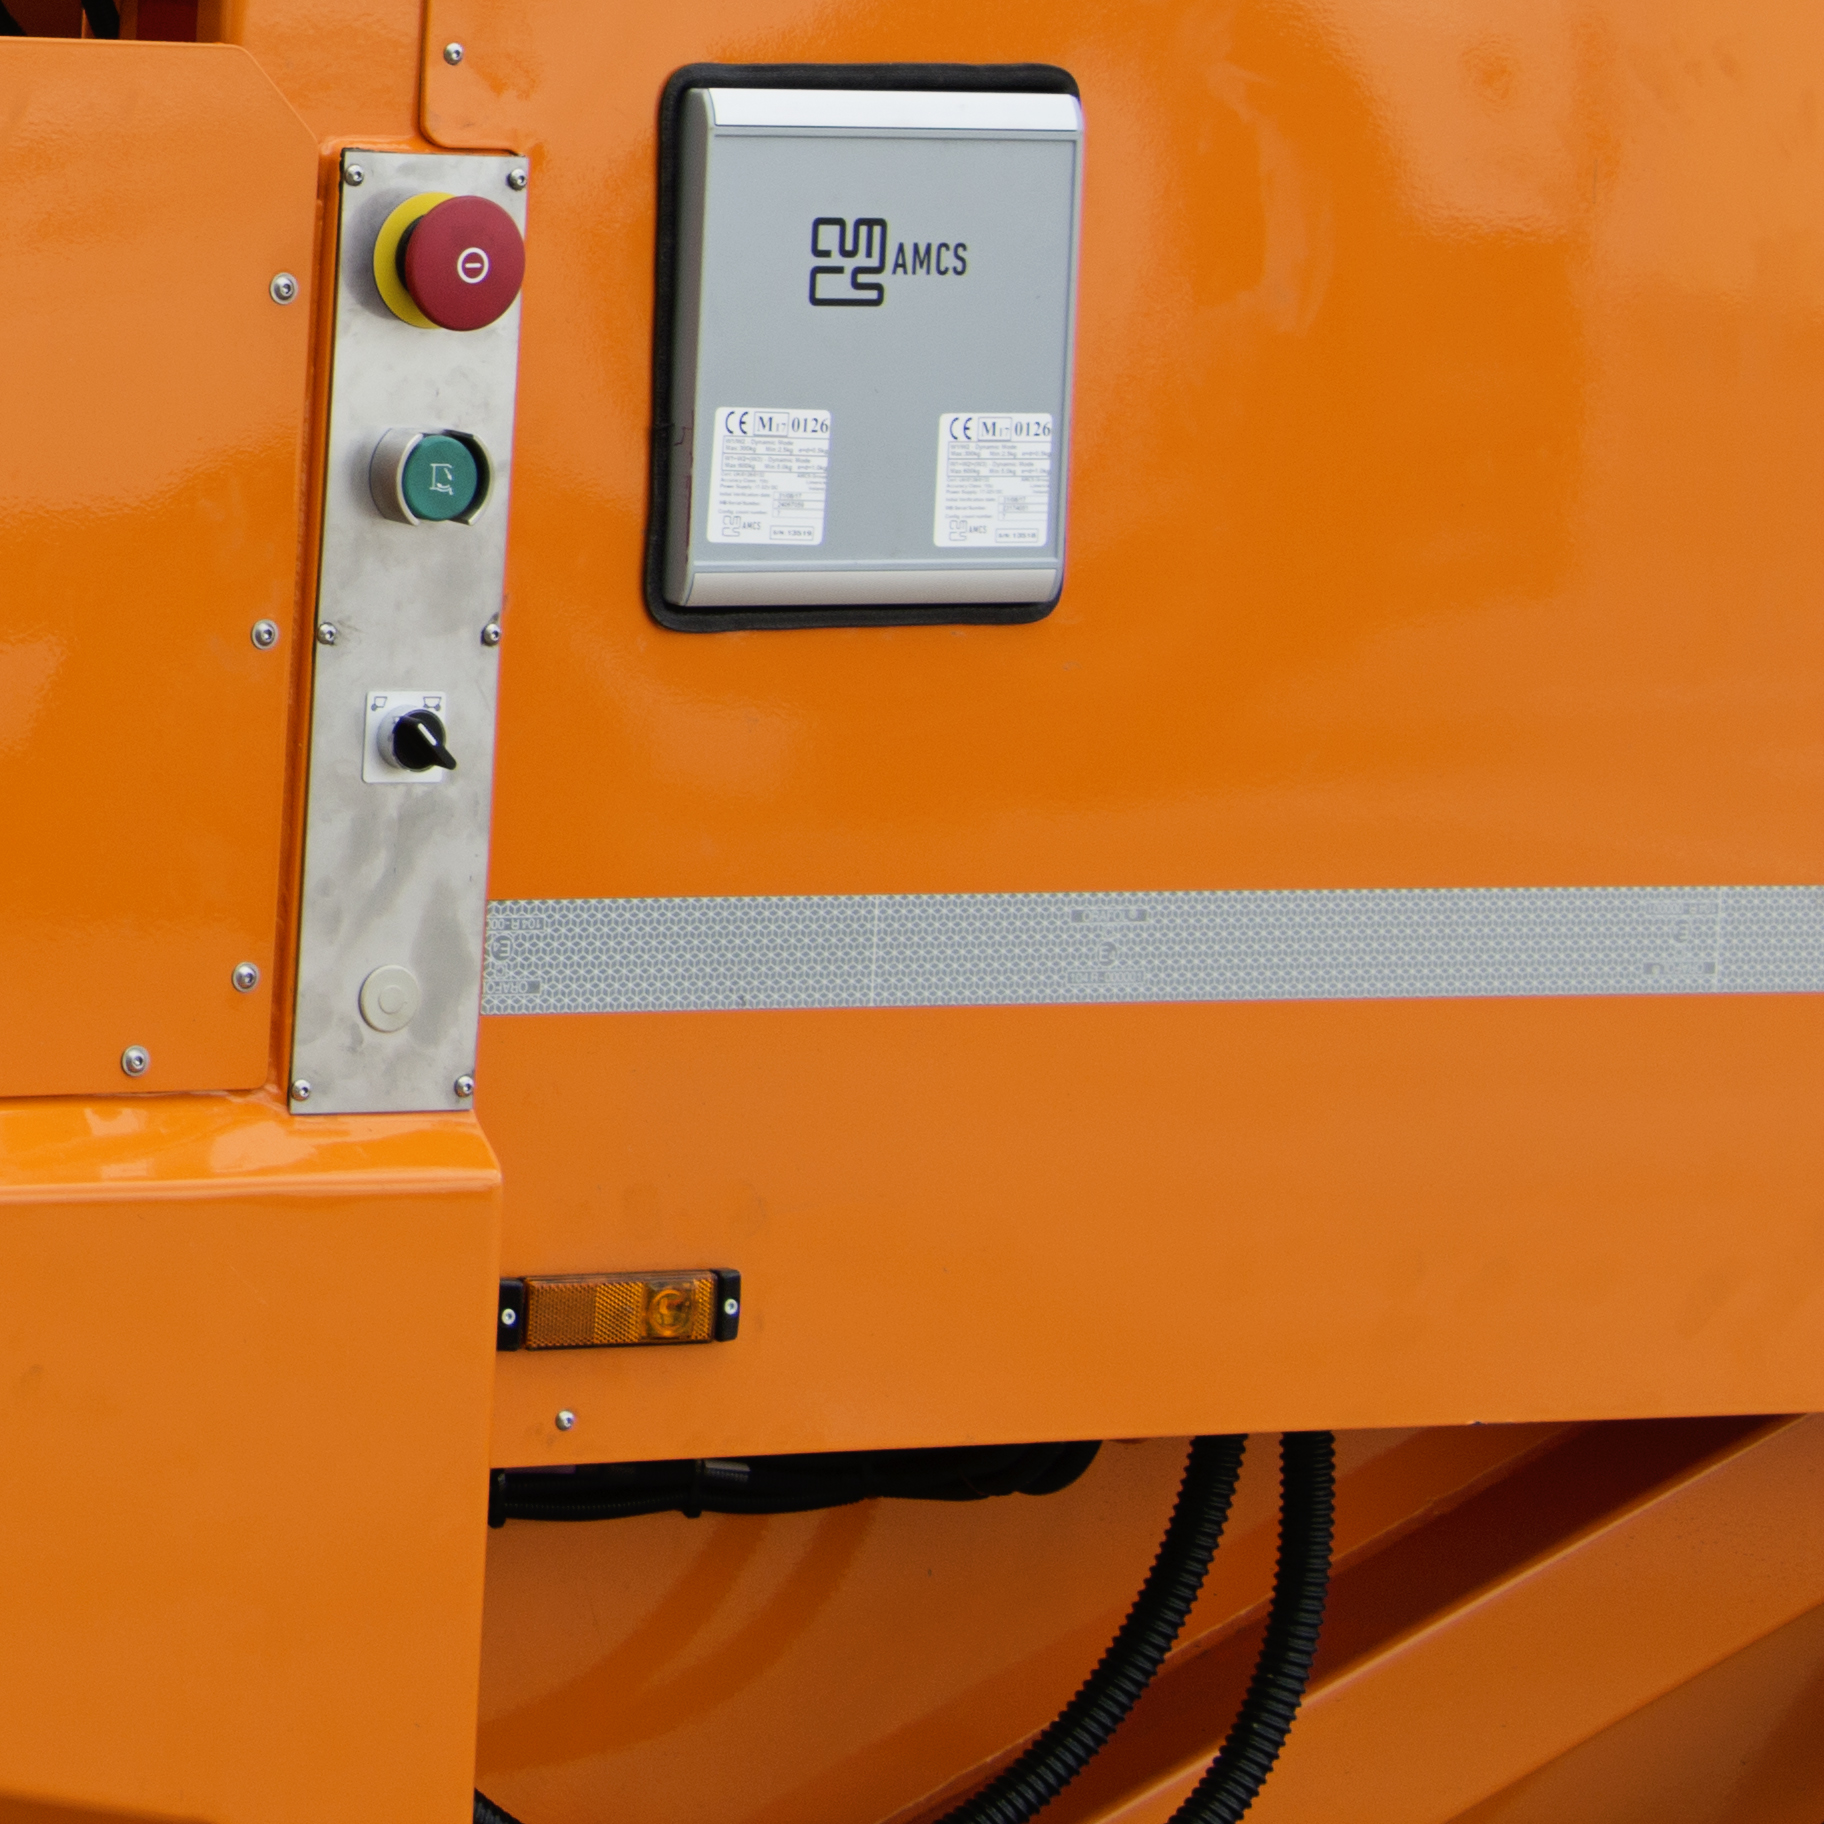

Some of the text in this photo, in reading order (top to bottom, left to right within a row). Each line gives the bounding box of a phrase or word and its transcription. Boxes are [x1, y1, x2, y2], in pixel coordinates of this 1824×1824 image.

[892, 242, 967, 276] AMCS
[757, 416, 773, 432] M
[792, 417, 829, 433] 0126
[981, 422, 997, 437] M
[1014, 421, 1051, 437] 0126
[483, 982, 529, 994] ORAFO
